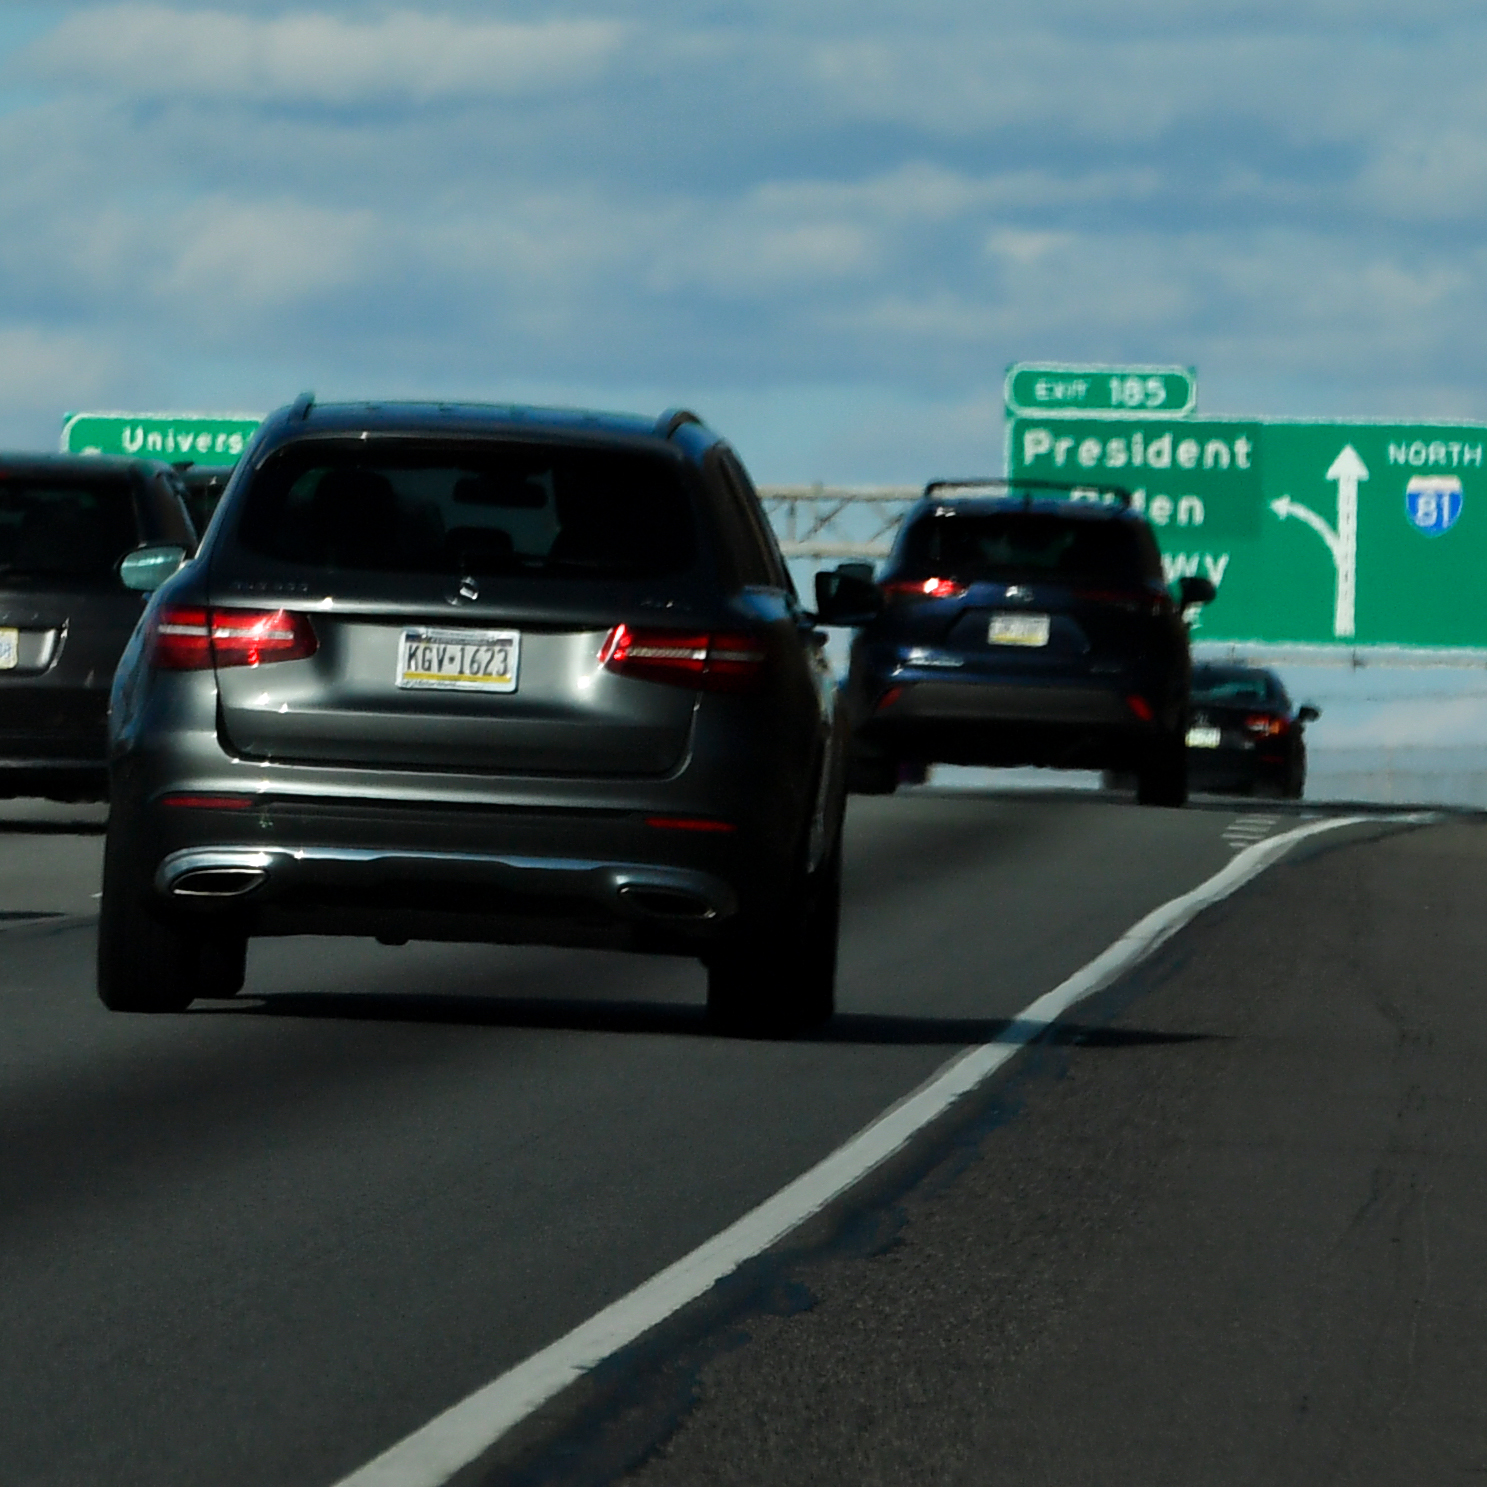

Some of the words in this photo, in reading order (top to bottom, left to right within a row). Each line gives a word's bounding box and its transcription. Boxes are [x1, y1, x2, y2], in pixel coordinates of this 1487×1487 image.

[1110, 376, 1167, 408] 185
[1023, 428, 1254, 470] President
[1388, 441, 1483, 469] NORTH
[1417, 494, 1452, 529] 81
